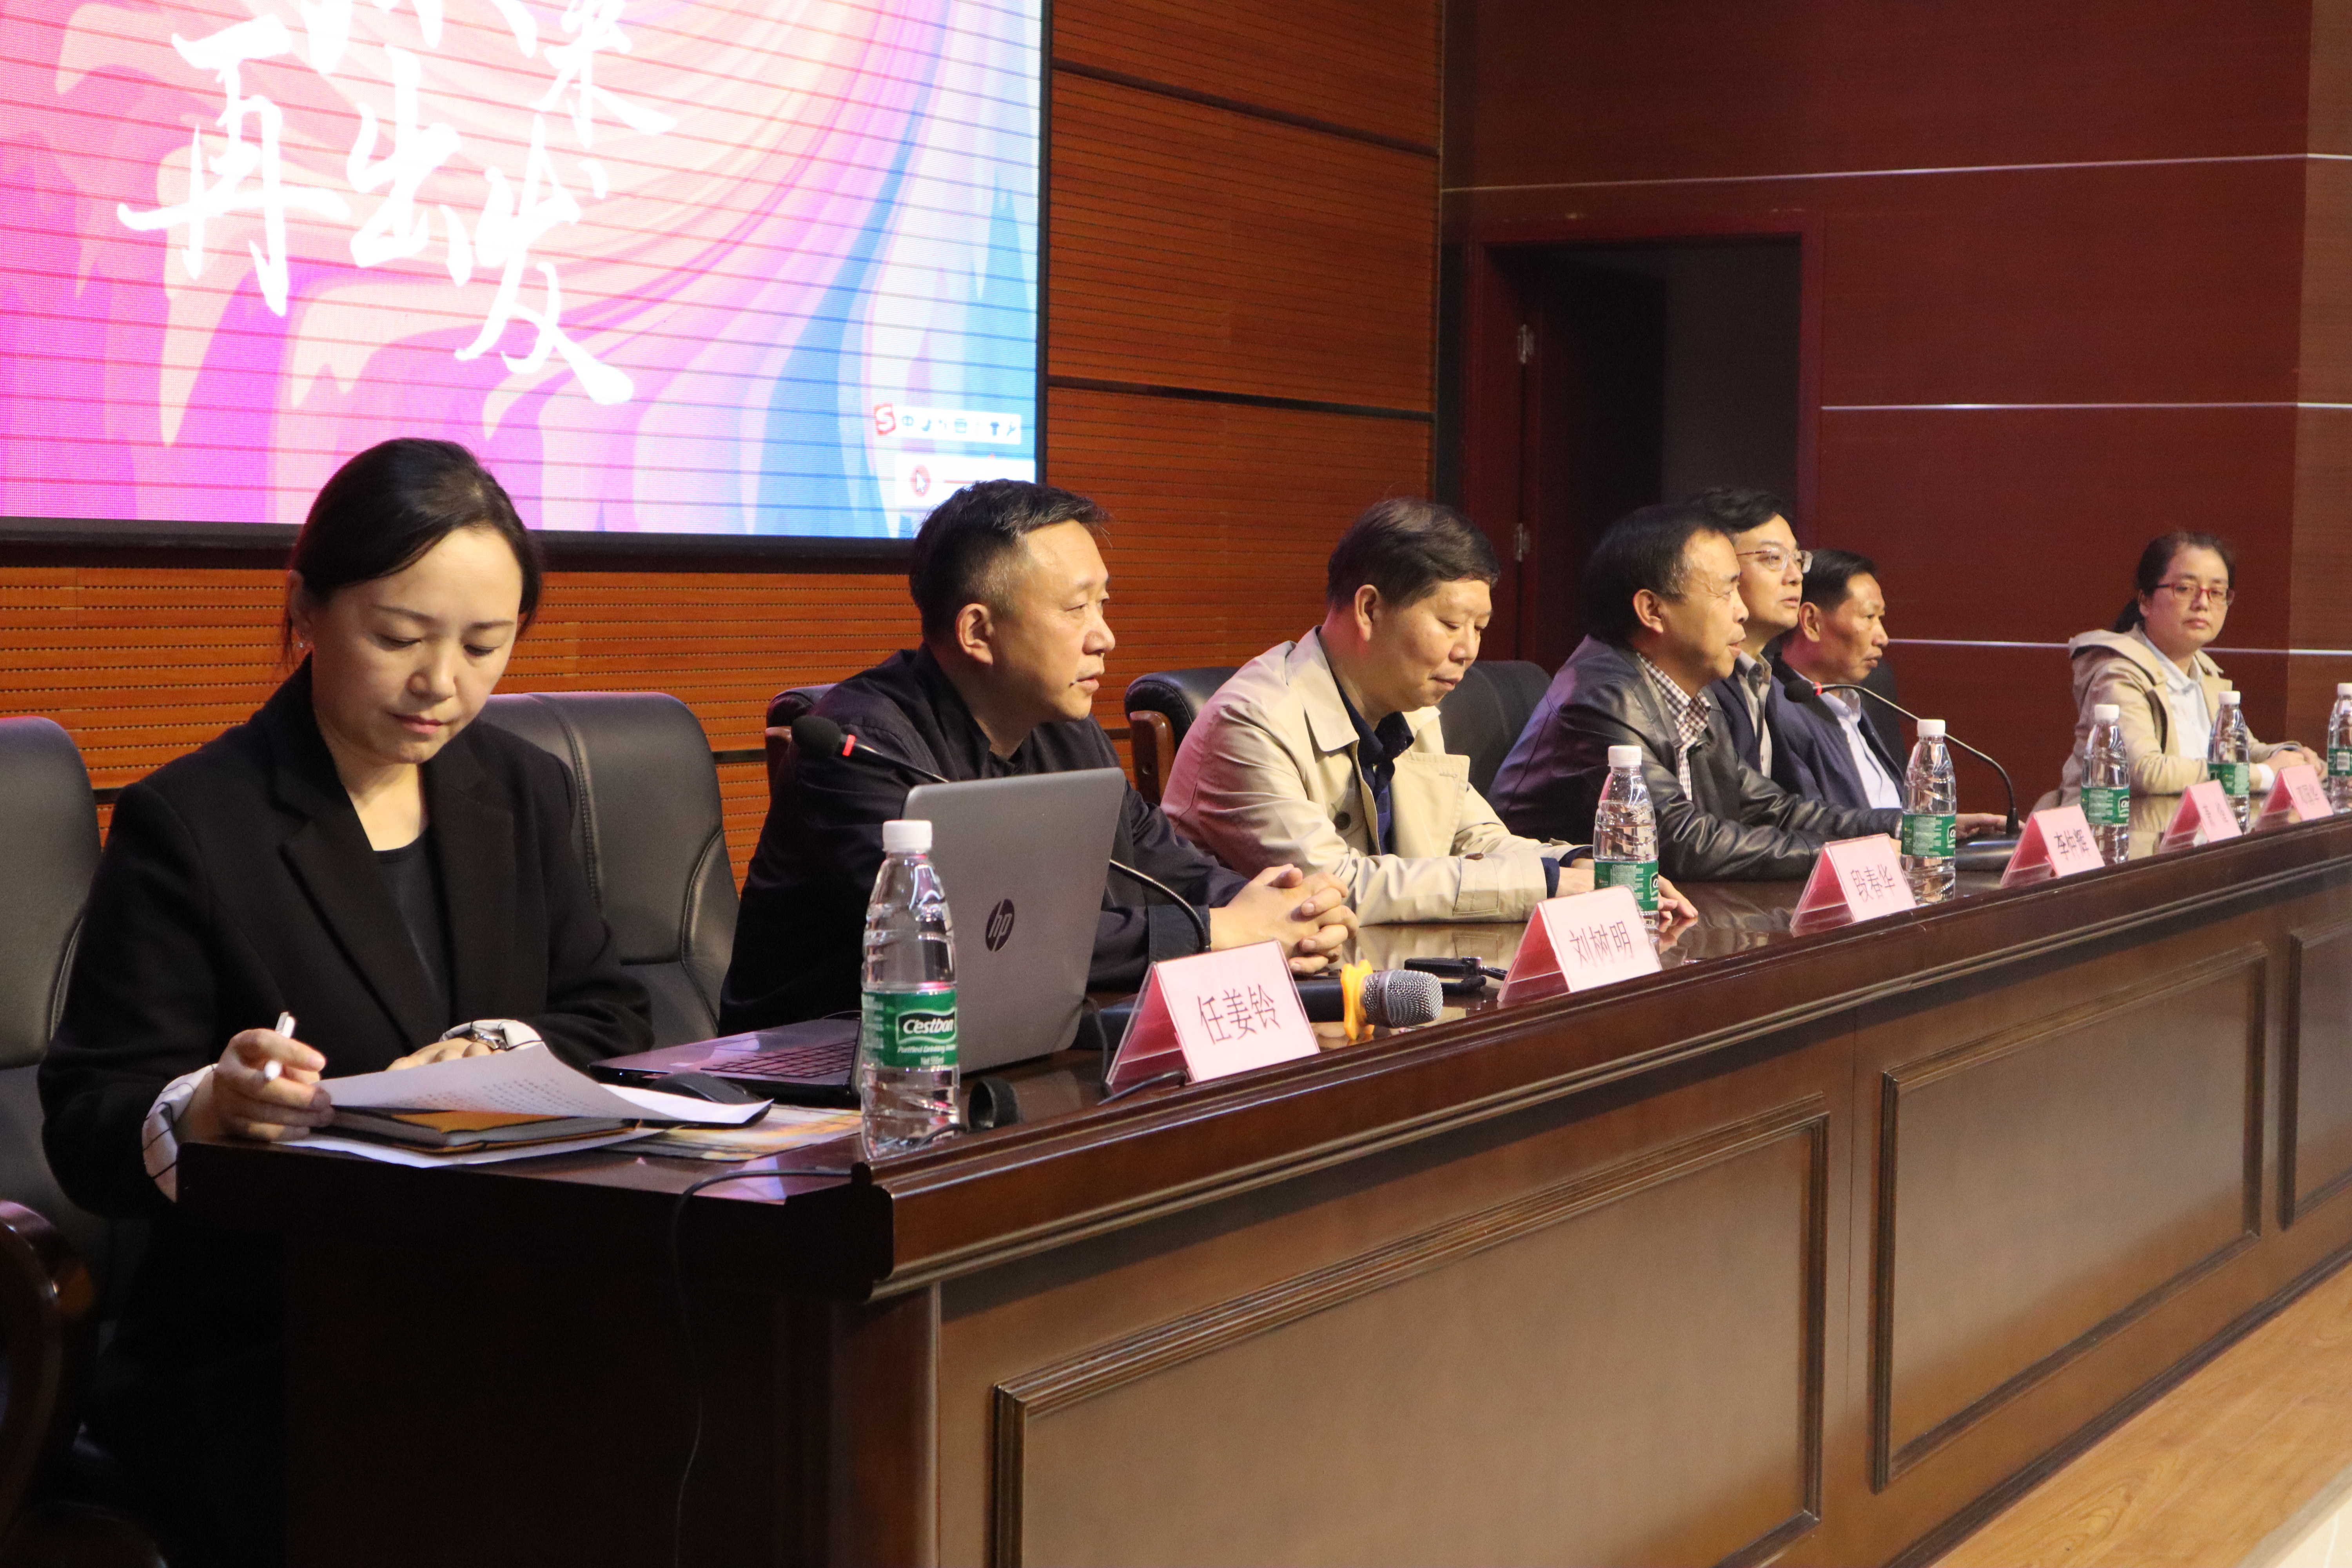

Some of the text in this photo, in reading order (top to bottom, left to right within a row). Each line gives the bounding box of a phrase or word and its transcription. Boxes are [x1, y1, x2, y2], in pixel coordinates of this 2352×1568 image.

[119, 12, 633, 404] 再出发
[1850, 864, 1896, 902] 段春华
[987, 899, 1013, 952] hp
[1569, 920, 1635, 969] 刘树明
[1197, 983, 1281, 1045] 任姜铃
